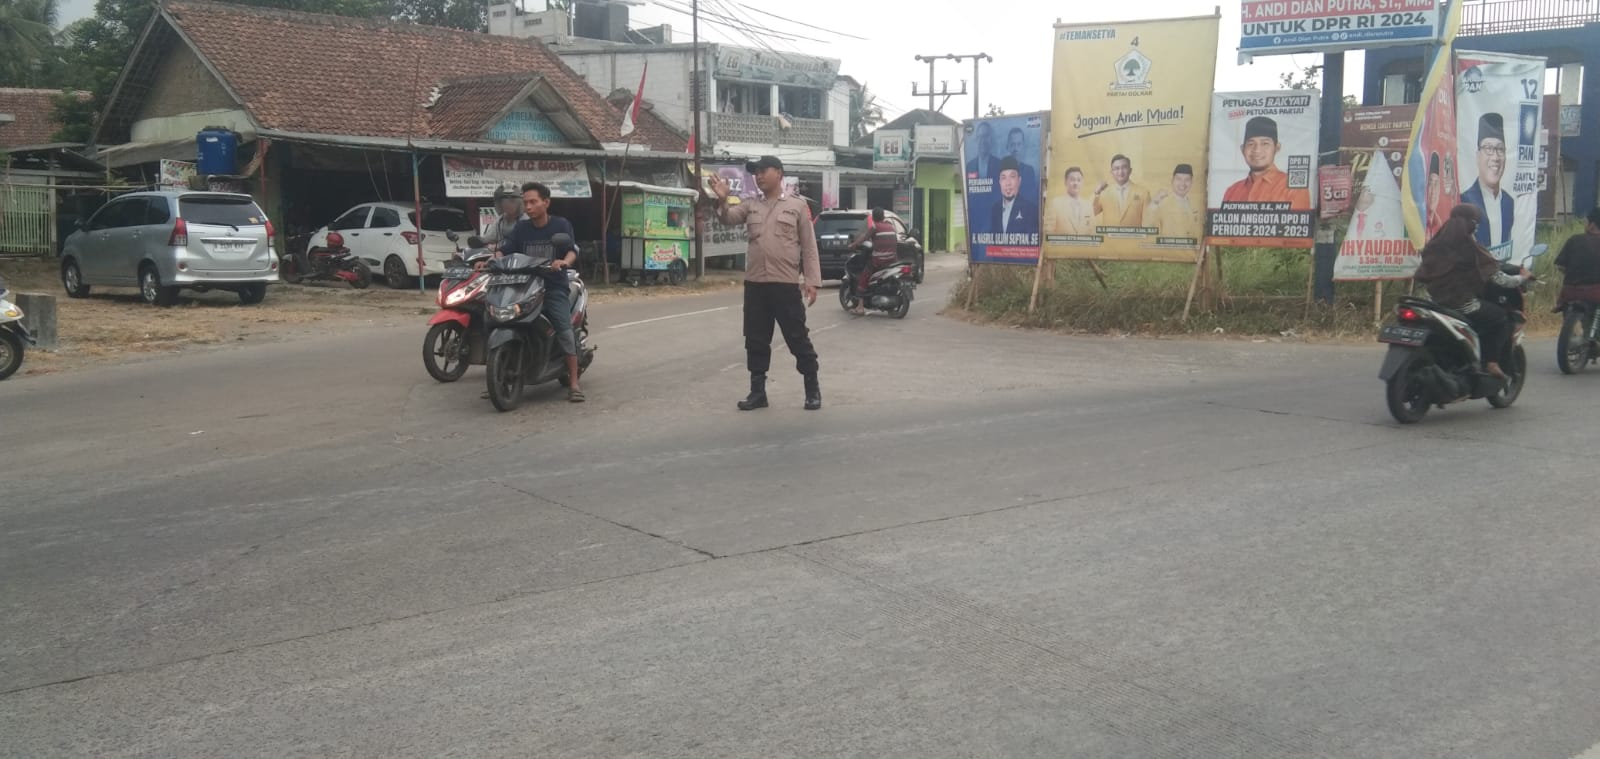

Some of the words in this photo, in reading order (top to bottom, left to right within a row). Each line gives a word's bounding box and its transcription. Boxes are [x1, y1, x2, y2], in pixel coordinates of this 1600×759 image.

[1255, 3, 1287, 17] ANDI
[1291, 0, 1325, 15] DIAN
[1327, 0, 1375, 13] PUTRA,
[1243, 19, 1306, 36] UNTUK
[1312, 16, 1351, 31] DPR
[1357, 15, 1375, 28] RI
[1381, 12, 1426, 27] 2024
[1060, 29, 1116, 40] #TEMANSETYA
[1131, 36, 1139, 47] 4
[1520, 79, 1538, 100] 12
[1222, 98, 1264, 107] PETUGAS
[1074, 114, 1111, 131] Jagoan
[1114, 110, 1144, 127] Anak
[1147, 105, 1184, 124] Muda!
[1246, 108, 1278, 116] PETUGAS
[1279, 107, 1304, 115] PARTAI
[883, 140, 899, 155] EG
[1519, 145, 1534, 160] PAN
[517, 160, 535, 171] AC
[1324, 187, 1333, 200] 3
[1223, 203, 1259, 211] PUJIYANTO,
[1212, 213, 1240, 224] CALON
[1241, 214, 1279, 224] ANGGOTA
[1281, 214, 1298, 224] DPD
[1300, 214, 1310, 224] RI
[1212, 224, 1253, 236] PERIODE
[1253, 226, 1277, 236] 2024
[1283, 226, 1309, 237] 2029
